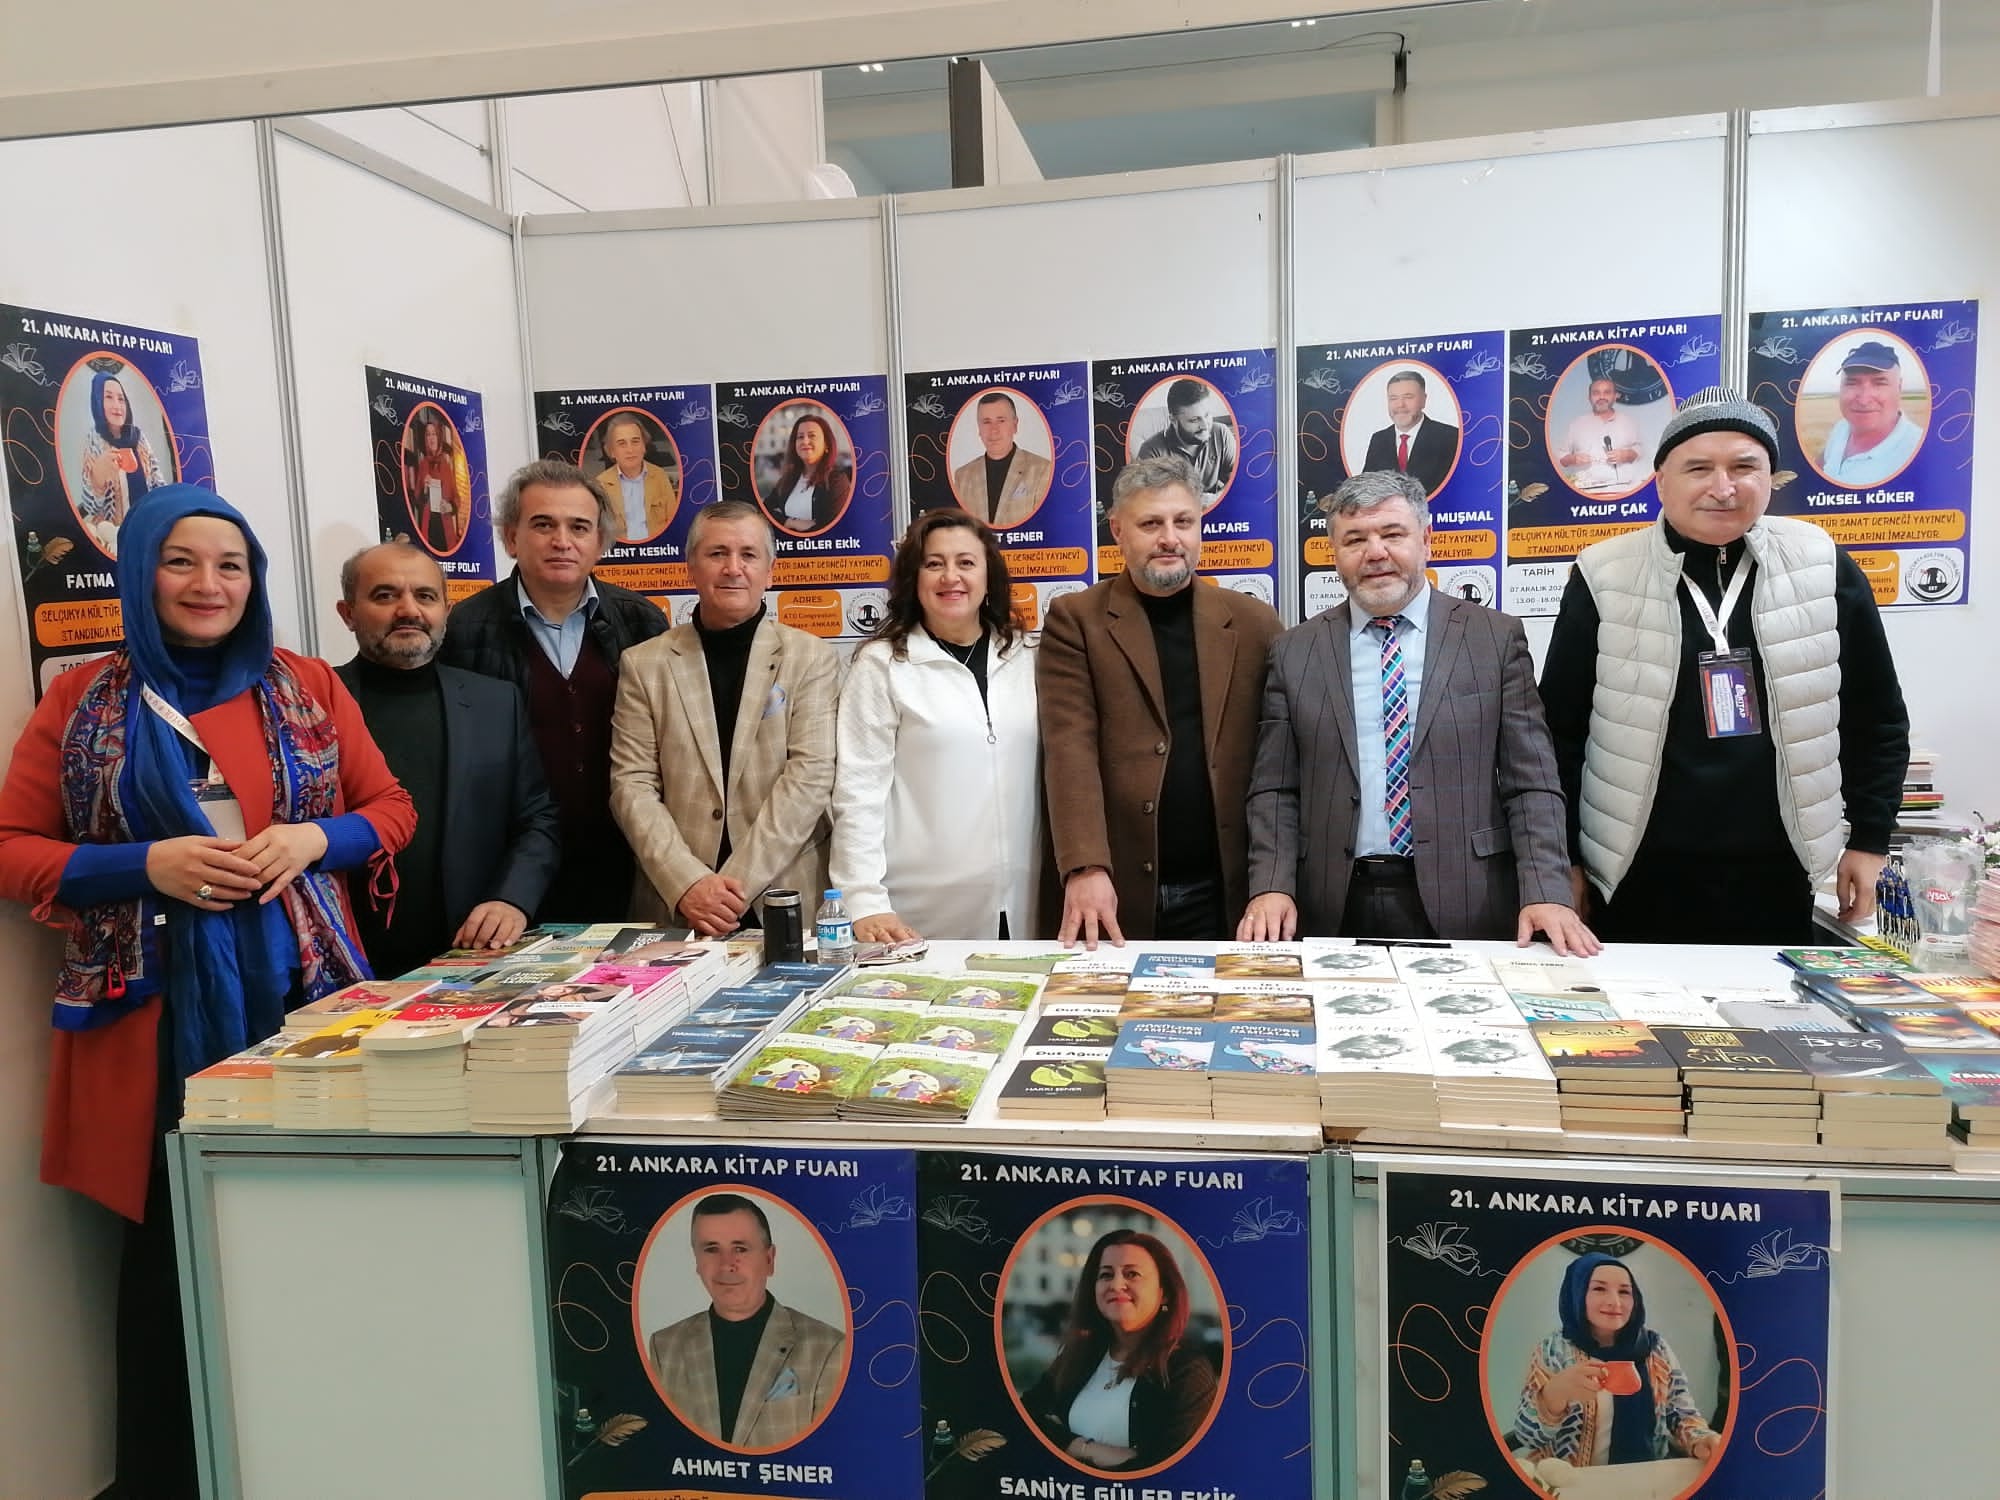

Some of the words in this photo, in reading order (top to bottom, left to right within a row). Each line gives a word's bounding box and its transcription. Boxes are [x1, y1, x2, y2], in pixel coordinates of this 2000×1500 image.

[1782, 317, 1798, 328] 21.
[1802, 314, 1858, 328] ANKARA
[1862, 310, 1901, 323] KİTAP
[1904, 308, 1944, 321] FUARI
[22, 318, 40, 334] 21.
[44, 322, 100, 343] ANKARA
[102, 329, 136, 349] KİTAP
[139, 337, 173, 355] FUARI
[1532, 334, 1547, 345] 21.
[1550, 330, 1604, 344] ANKARA
[1608, 326, 1646, 339] KİTAP
[1650, 324, 1687, 336] FUARI
[1326, 351, 1340, 360] 21.
[1344, 347, 1394, 359] ANKARA
[1397, 342, 1434, 355] KİTAP
[1437, 339, 1472, 352] FUARI
[1111, 366, 1124, 375] 21.
[1128, 362, 1174, 375] ANKARA
[1177, 358, 1210, 371] KİTAP
[1214, 357, 1246, 368] FUARI
[931, 378, 944, 387] 21.
[946, 374, 991, 386] ANKARA
[994, 371, 1026, 383] KİTAP
[1029, 370, 1060, 380] FUARI
[385, 377, 395, 389] 21.
[397, 380, 426, 396] ANKARA
[427, 385, 447, 400] KİTAP
[448, 392, 467, 405] FUARI
[734, 388, 747, 397] 21.
[750, 386, 794, 396] ANKARA
[796, 382, 827, 394] KİTAP
[830, 382, 860, 392] FUARI
[560, 396, 574, 405] 21.
[576, 394, 620, 405] ANKARA
[622, 392, 653, 403] KİTAP
[655, 391, 684, 400] FUARI
[1807, 493, 1861, 506] YÜKSEL
[1866, 491, 1914, 504] KÖKER
[1437, 511, 1494, 524] MUŞMAL
[1570, 504, 1616, 517] YAKUP
[1621, 503, 1648, 516] ÇAK
[1310, 519, 1326, 528] PR
[1840, 518, 1869, 527] SANAT
[1913, 512, 1955, 524] YAYINEVİ
[1203, 522, 1250, 534] ALPARS
[776, 539, 793, 551] İYE
[797, 539, 832, 550] GÜLER
[836, 537, 860, 548] EKİK
[1006, 531, 1043, 544] ŞENER
[1449, 532, 1488, 544] YAYINEVİ
[1512, 530, 1552, 543] SELÇUKYA
[1830, 532, 1886, 541] İTAPLARINI
[601, 547, 636, 558] LENT
[640, 543, 679, 556] KESKİN
[1229, 541, 1265, 552] YAYINEVİ
[1431, 549, 1472, 558] MZALIYOR
[458, 562, 480, 572] POLAT
[1522, 568, 1555, 577] TARİH
[66, 572, 114, 588] FATMA
[1321, 576, 1341, 584] TAR
[1687, 1047, 1777, 1065] Sultan
[596, 1156, 622, 1172] 21.
[629, 1156, 719, 1175] ANKARA
[725, 1153, 789, 1176] KİTAP
[795, 1159, 858, 1177] FUARI
[960, 1164, 988, 1182] 21.
[995, 1164, 1092, 1185] ANKARA
[1098, 1164, 1168, 1188] KİTAP
[1175, 1170, 1244, 1190] FUARI
[1450, 1189, 1480, 1209] 21.
[1488, 1192, 1594, 1215] ANKARA
[1602, 1193, 1679, 1218] KİTAP
[1686, 1201, 1761, 1222] FUARI
[671, 1457, 751, 1479] AHMET
[758, 1464, 833, 1485] ŞENER
[1000, 1476, 1085, 1500] SANİYE
[1094, 1483, 1172, 1500] GÜLER
